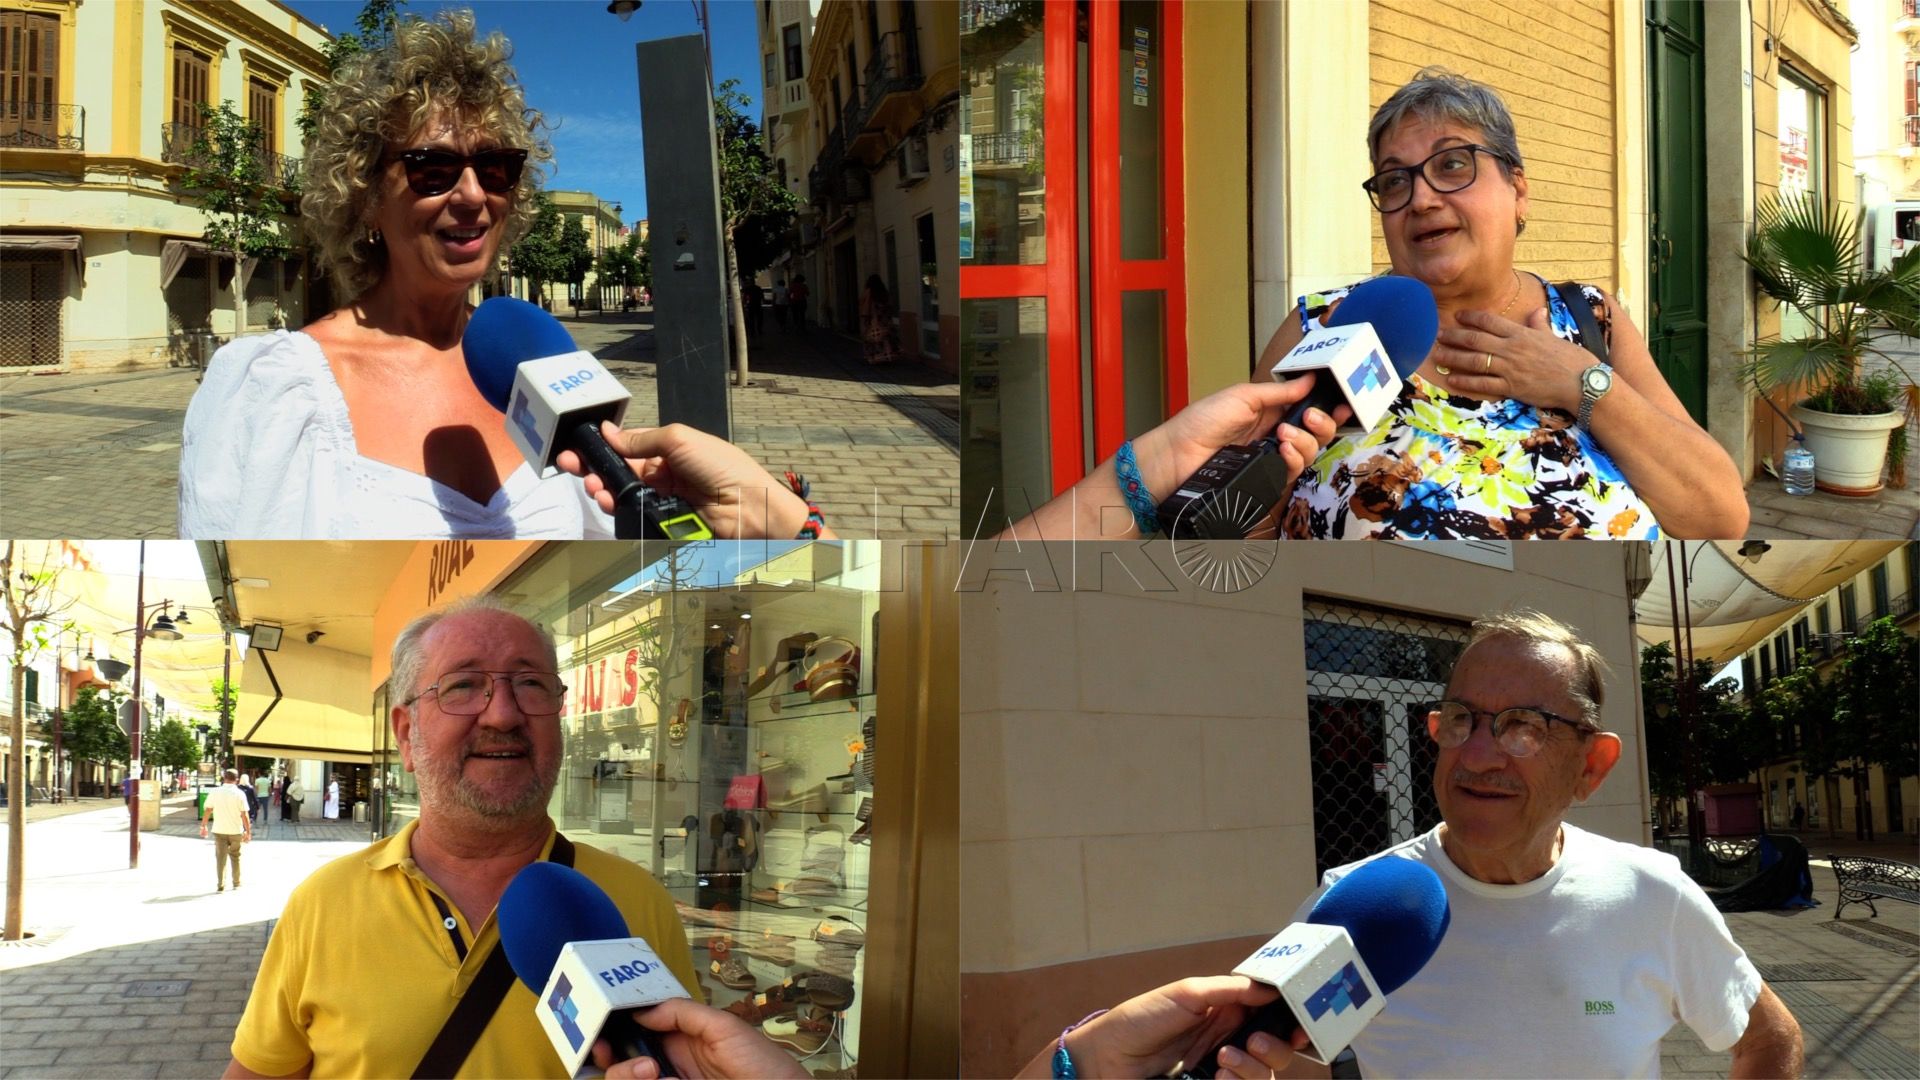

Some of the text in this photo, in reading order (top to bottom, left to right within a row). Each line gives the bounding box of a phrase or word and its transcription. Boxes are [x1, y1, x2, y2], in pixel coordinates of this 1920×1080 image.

[1293, 337, 1340, 357] FARO
[548, 369, 594, 395] FARO
[1255, 944, 1302, 959] FARO
[599, 960, 650, 987] FARO
[1585, 1000, 1615, 1012] BOSS
